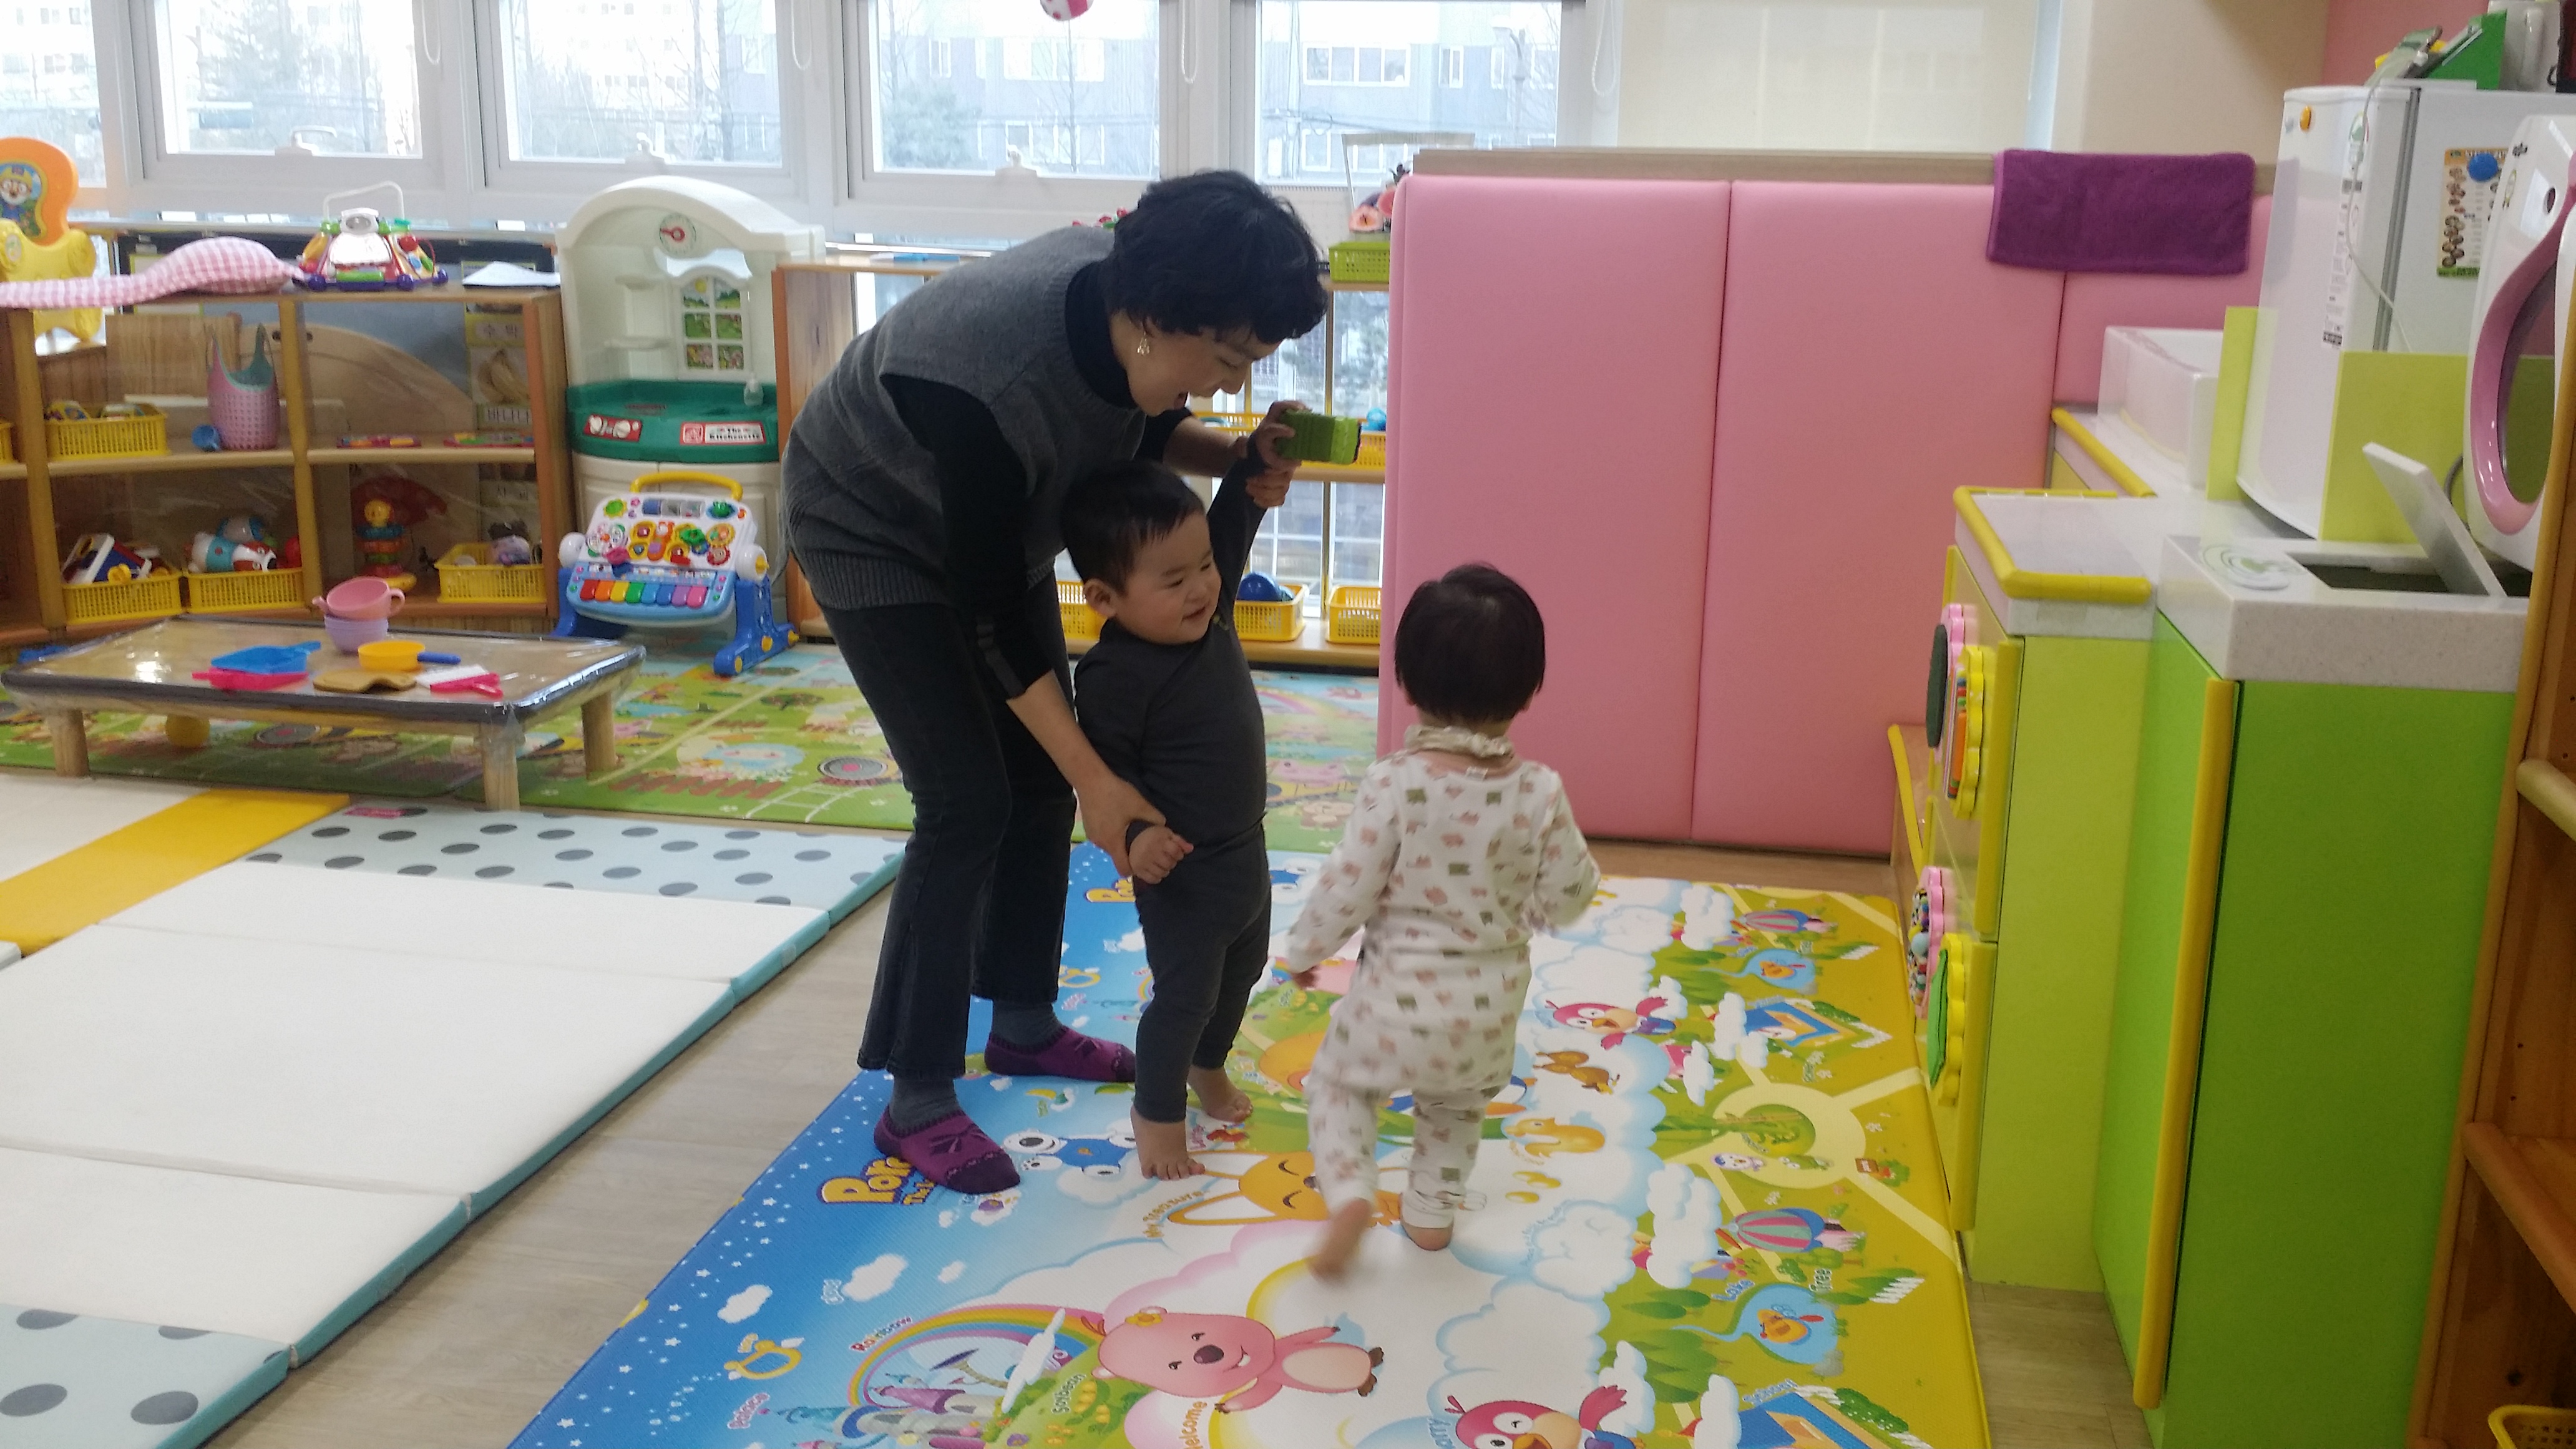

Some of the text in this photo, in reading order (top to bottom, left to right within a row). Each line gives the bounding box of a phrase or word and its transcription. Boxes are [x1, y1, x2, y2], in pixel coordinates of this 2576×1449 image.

[849, 1317, 912, 1352] Rainbow
[1051, 1373, 1086, 1414] Soybean
[1178, 1401, 1208, 1449] elcome
[1427, 1418, 1458, 1449] arry
